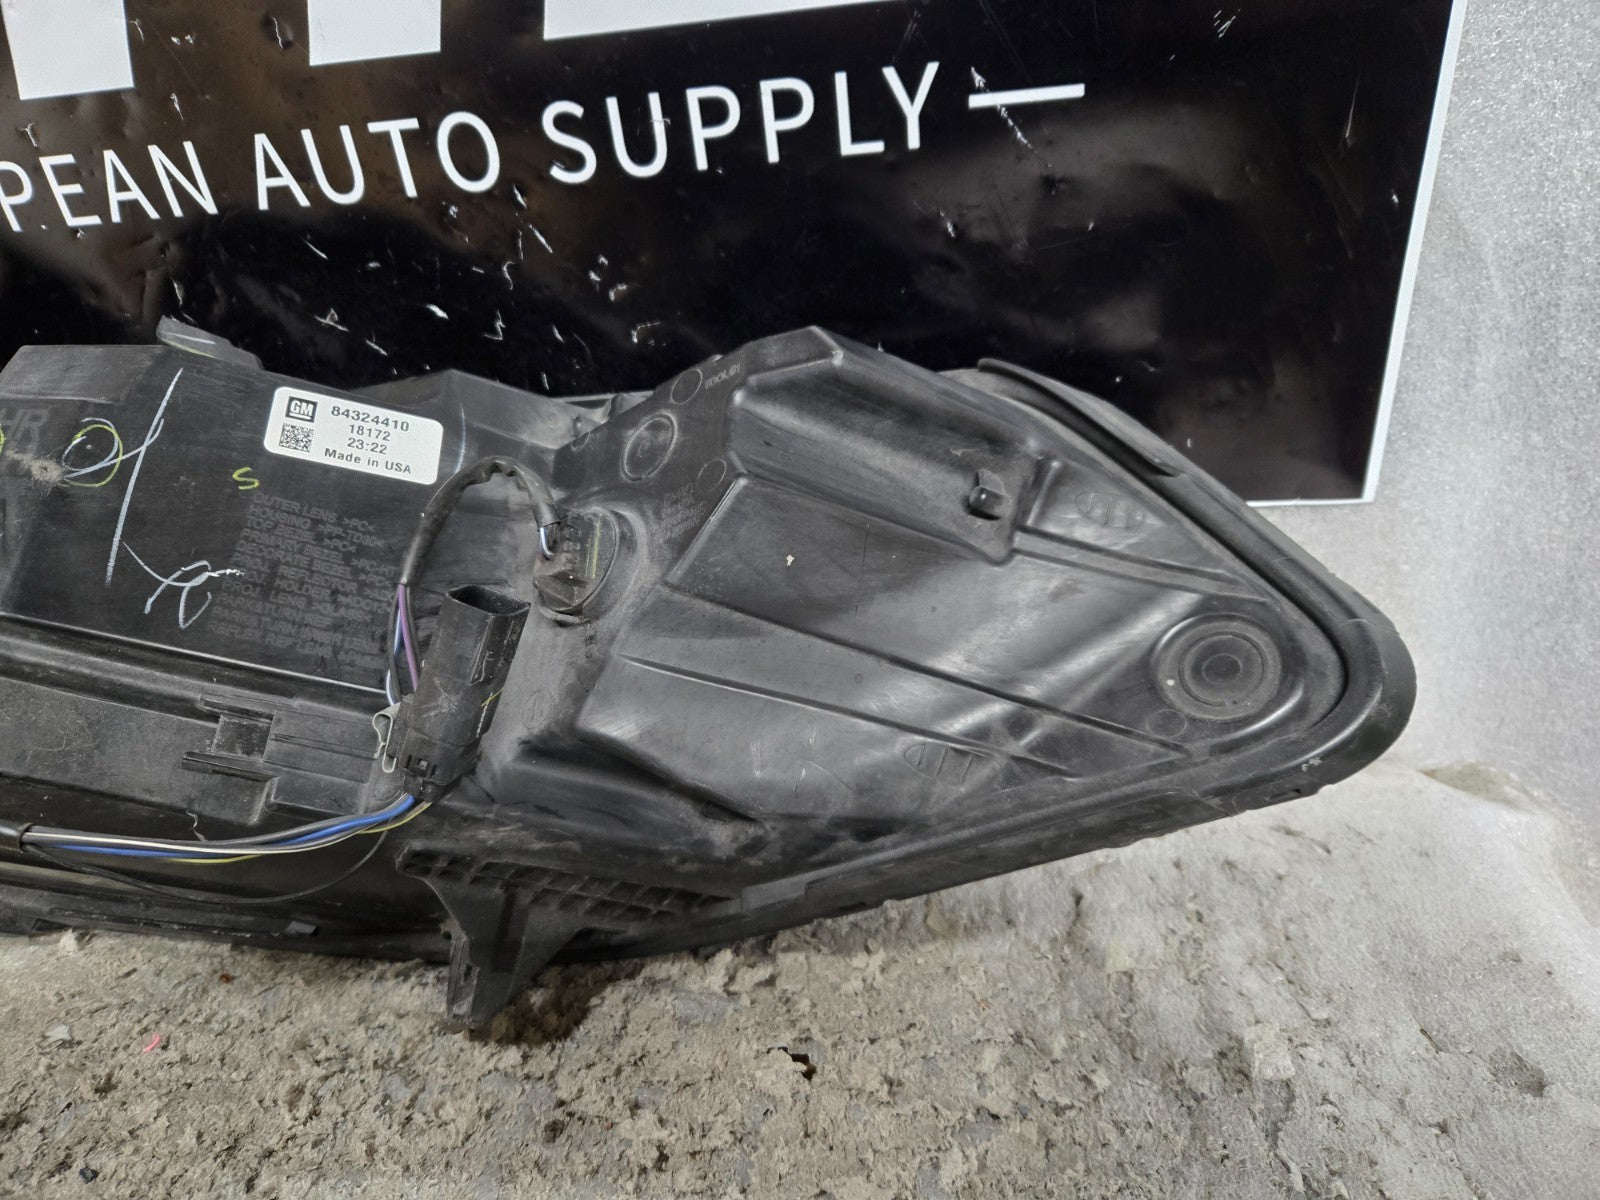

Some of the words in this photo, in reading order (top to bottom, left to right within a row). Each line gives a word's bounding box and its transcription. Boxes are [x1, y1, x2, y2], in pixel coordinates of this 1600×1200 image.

[0, 141, 219, 232] PEAN
[254, 111, 500, 210] AUTO
[541, 61, 939, 184] SUPPLY
[289, 399, 314, 417] GM
[331, 405, 410, 432] 84324410
[349, 424, 391, 441] 18172
[347, 437, 388, 455] 23:22
[324, 448, 361, 464] Made
[367, 457, 379, 467] in
[385, 460, 411, 474] USA
[248, 504, 311, 530] HOUSING
[253, 491, 302, 514] OUTER
[302, 504, 337, 523] LENS
[273, 577, 331, 600] HOLDER
[277, 564, 358, 594] REFLECTOR
[269, 589, 307, 608] LENS
